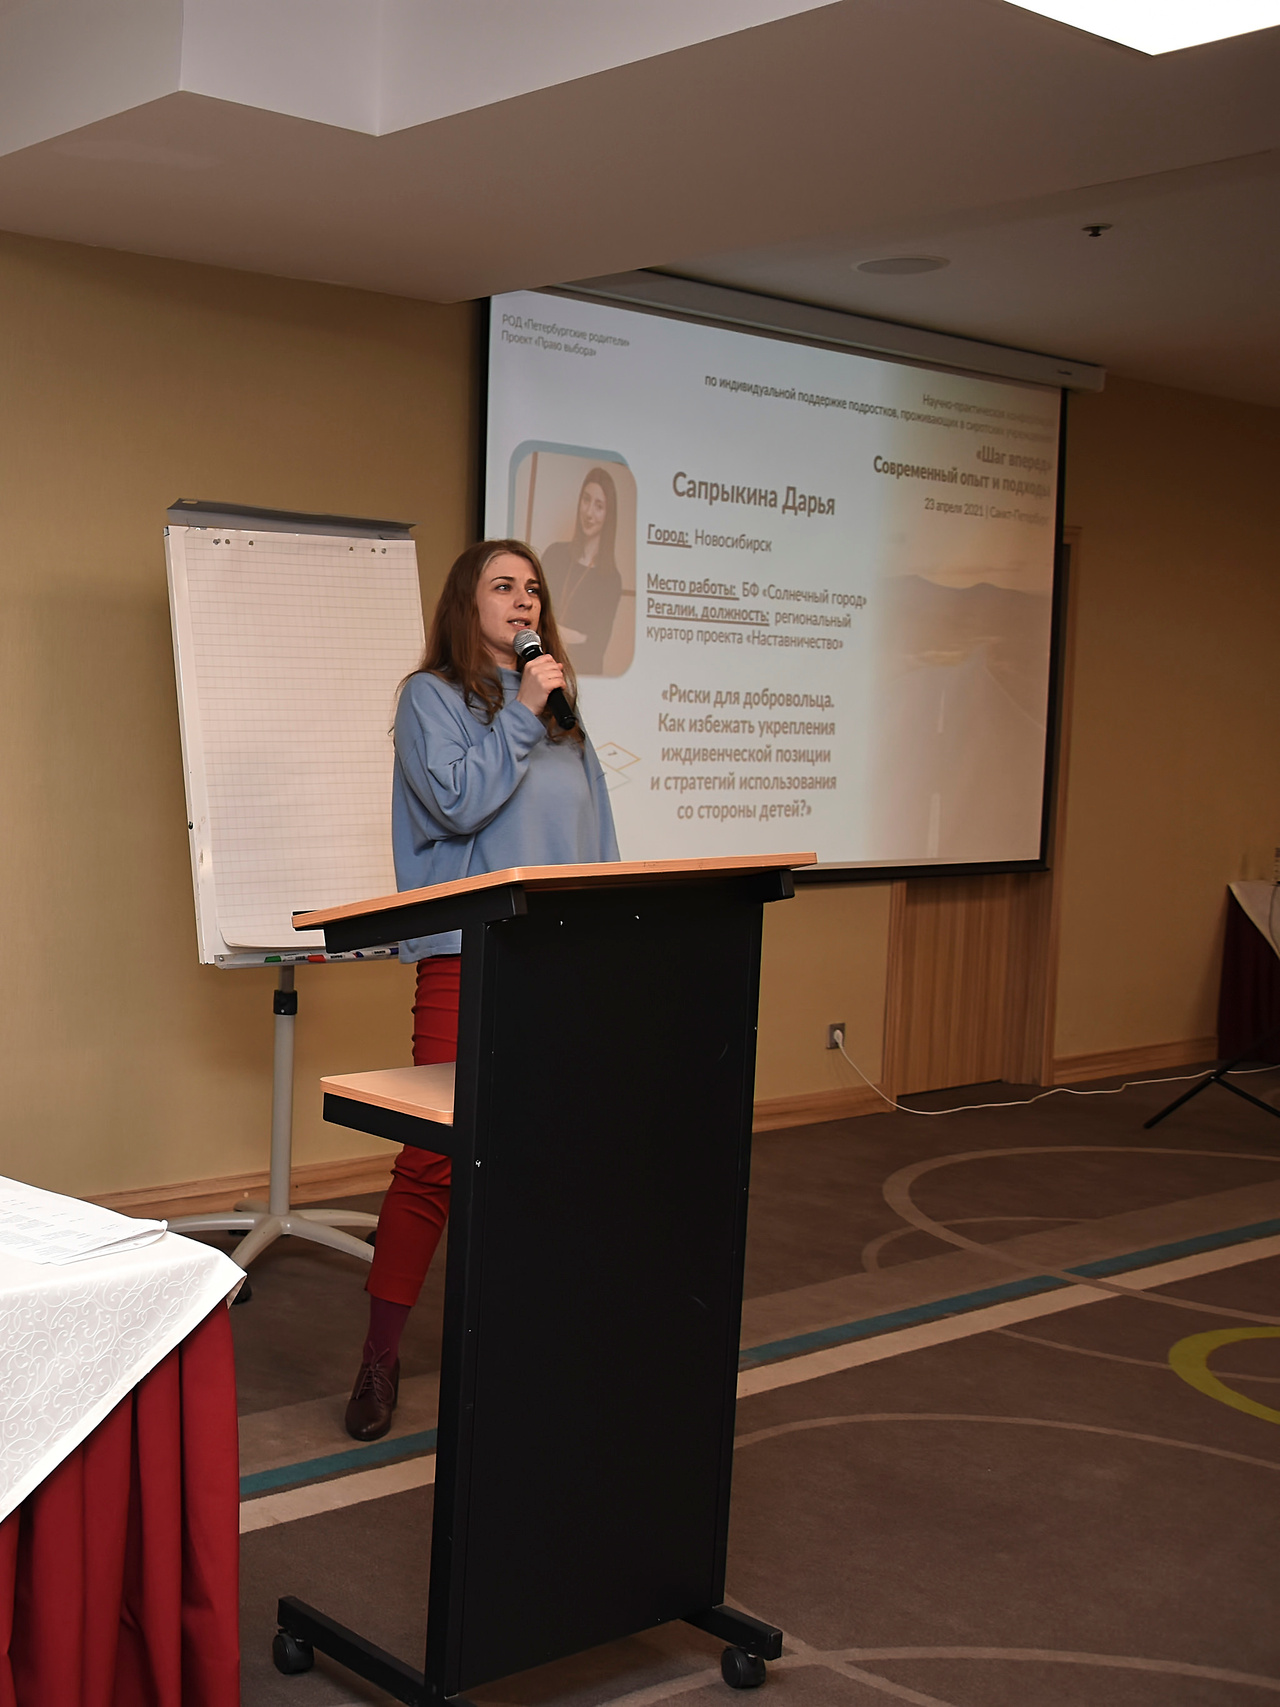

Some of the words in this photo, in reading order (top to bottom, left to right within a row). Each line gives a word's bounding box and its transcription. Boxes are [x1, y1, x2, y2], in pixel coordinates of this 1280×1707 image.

[502, 314, 523, 329] РОД
[501, 330, 533, 345] Проект
[704, 375, 717, 387] по
[719, 377, 796, 400] индивидуальной
[797, 391, 847, 410] поддержке
[848, 400, 900, 419] подростков,
[976, 445, 1007, 465] «Шаг
[873, 454, 959, 485] Современный
[959, 472, 990, 490] опыт
[992, 477, 1000, 490] и
[1002, 478, 1052, 499] подходы
[672, 471, 778, 507] Сапрыкина
[781, 485, 836, 517] Дарья
[924, 497, 935, 511] 23
[936, 501, 963, 515] апреля
[963, 502, 984, 517] 2021
[646, 523, 690, 547] Город:
[694, 529, 773, 554] Новосибирск
[646, 573, 687, 594] Место
[688, 578, 737, 598] работы:
[742, 581, 760, 598] БФ
[762, 583, 829, 605] «Солнечный
[831, 591, 868, 610] город»
[646, 597, 698, 618] Регалии,
[700, 604, 770, 624] должность:
[774, 610, 852, 629] региональный
[646, 624, 694, 643] куратор
[696, 629, 744, 645] проекта
[745, 629, 844, 650] «Наставничество»
[661, 683, 711, 705] «Риски
[713, 689, 740, 708] для
[742, 687, 835, 711] добровольца.
[657, 712, 686, 733] Как
[688, 714, 755, 734] избежать
[757, 719, 836, 738] укрепления
[661, 744, 771, 766] иждивенческой
[775, 748, 832, 767] позиции
[650, 776, 660, 791] и
[663, 772, 736, 795] стратегий
[739, 775, 837, 791] использования
[676, 805, 694, 820] со
[697, 804, 756, 822] стороны
[758, 799, 813, 821] детей?»
